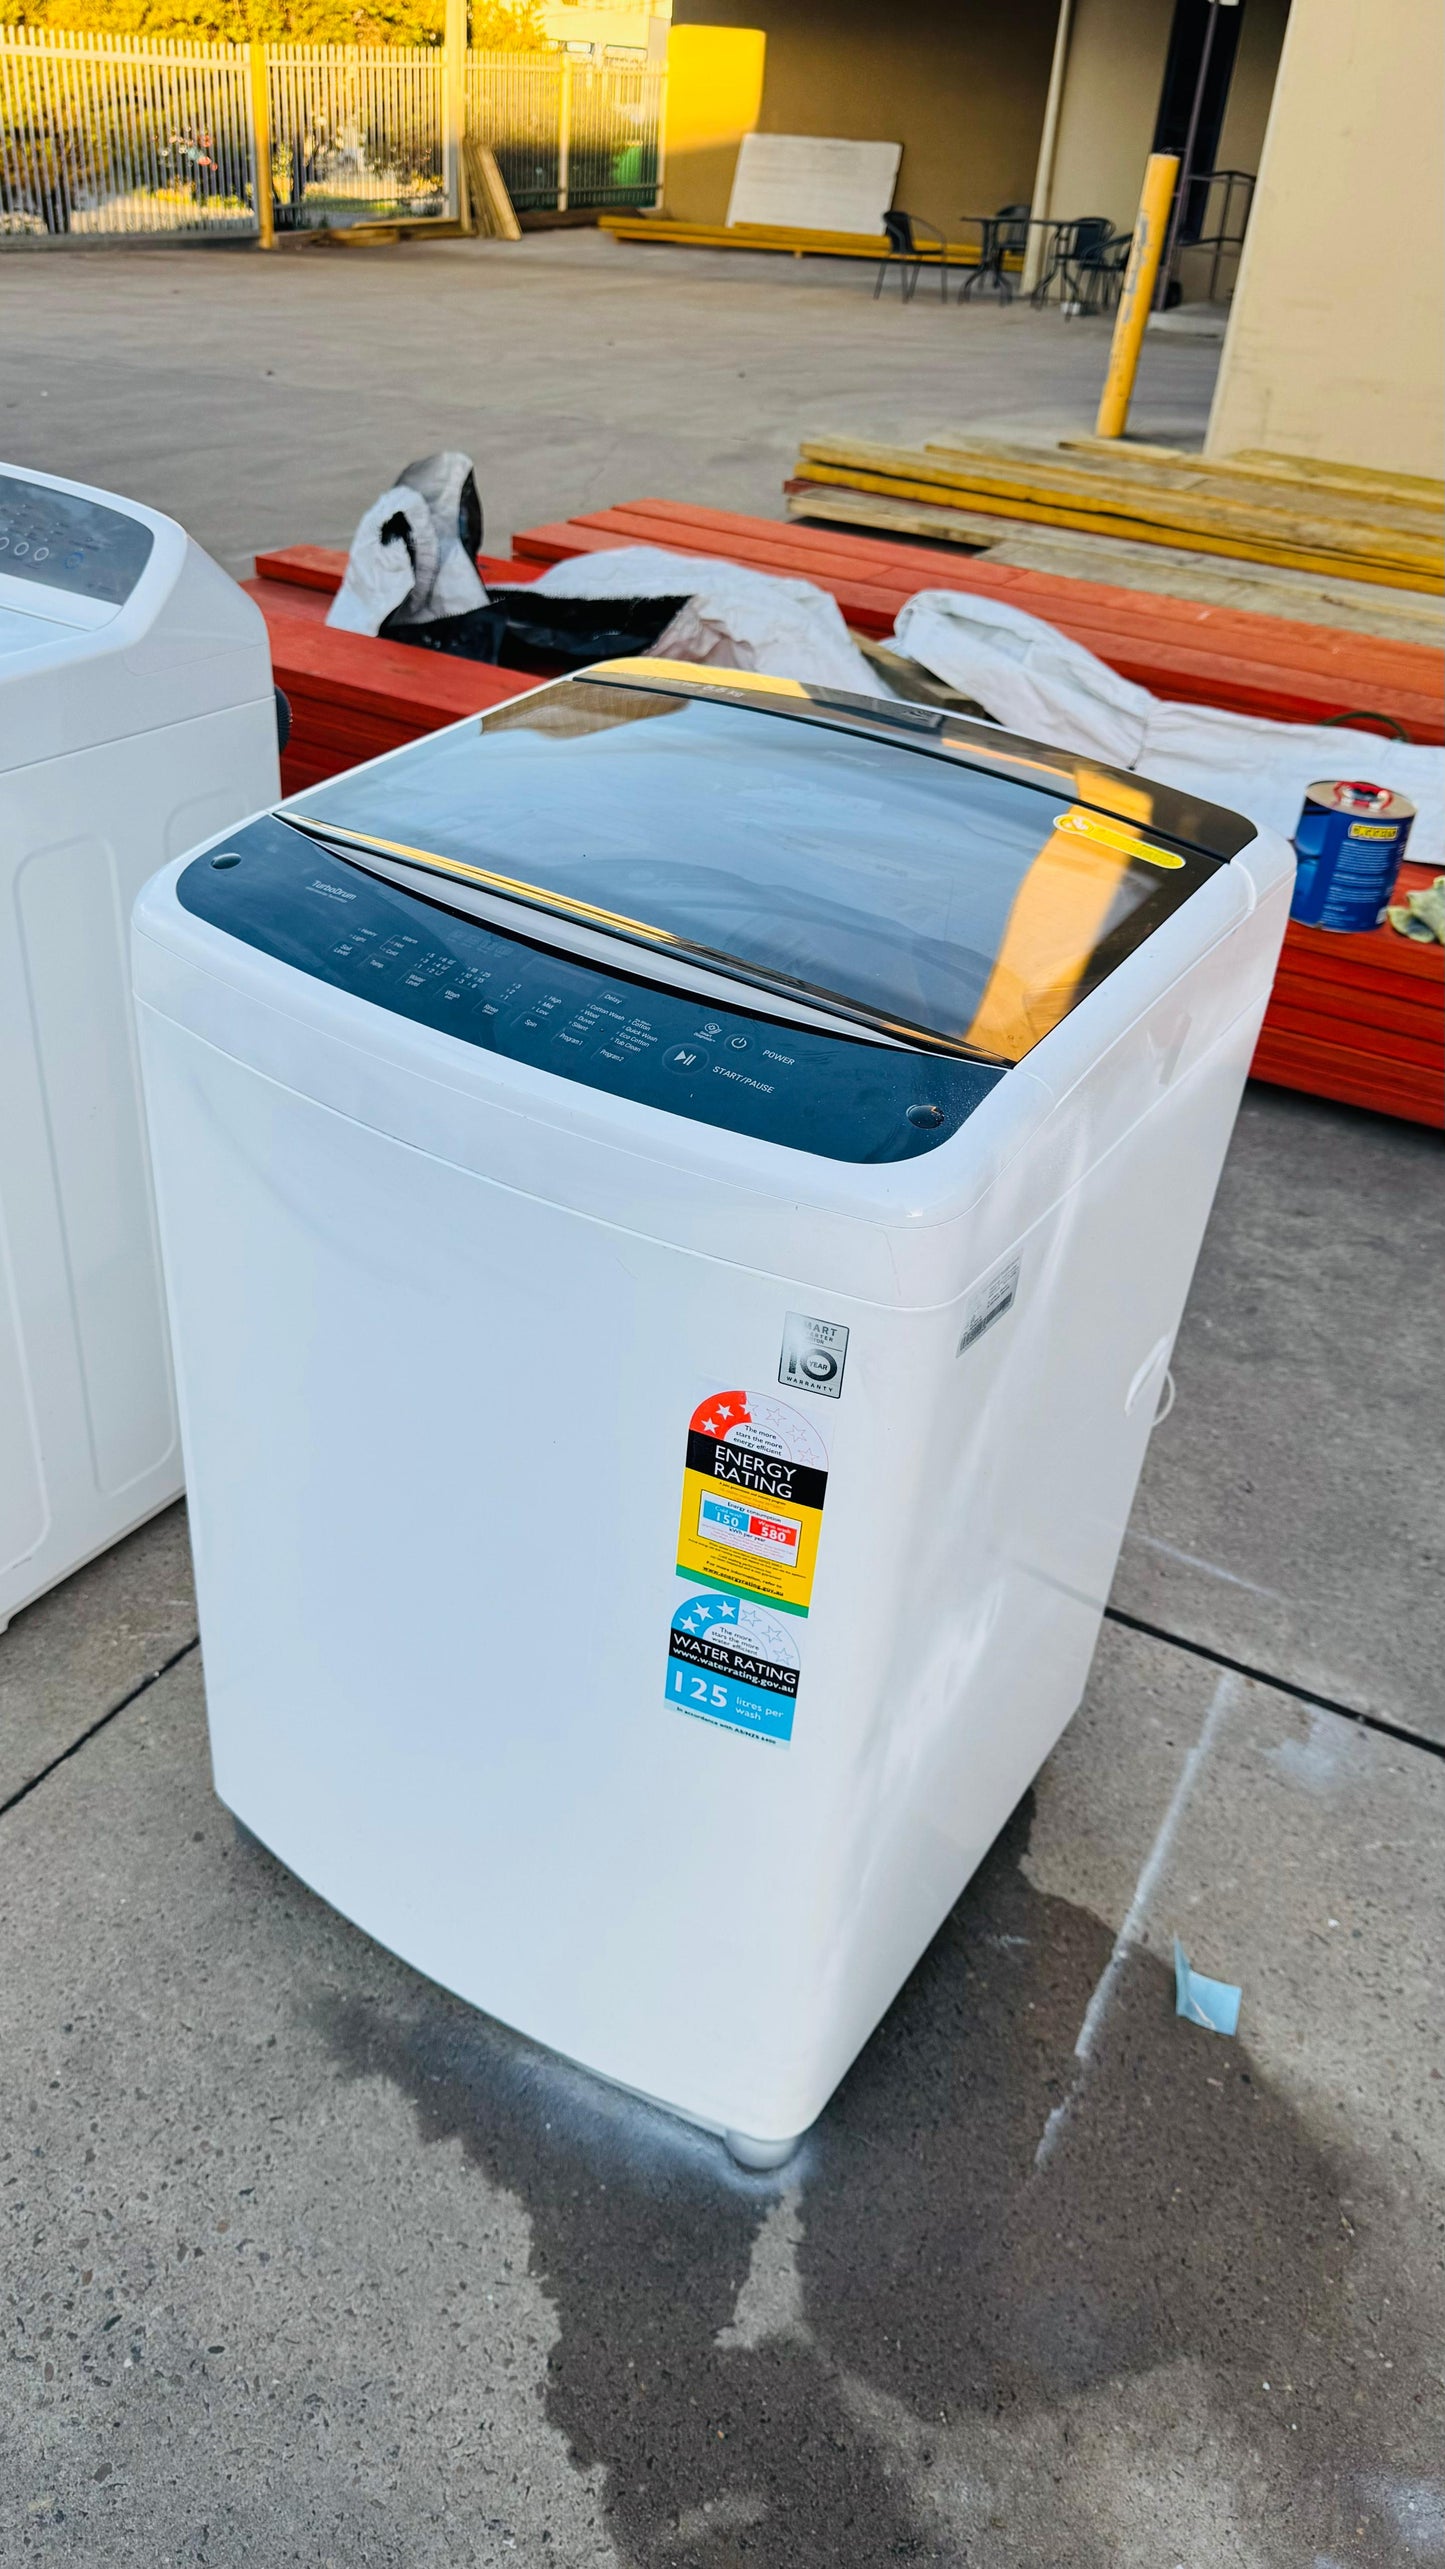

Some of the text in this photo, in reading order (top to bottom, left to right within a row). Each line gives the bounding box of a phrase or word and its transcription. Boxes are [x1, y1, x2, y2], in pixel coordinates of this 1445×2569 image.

[312, 880, 357, 900] TurboDrum
[402, 935, 418, 944] Warm
[333, 947, 350, 957] Level
[385, 948, 399, 956] Cold
[543, 1000, 555, 1009] Mid
[549, 995, 562, 1004] High
[604, 993, 622, 1005] Delay
[536, 1007, 549, 1016] Low
[584, 1009, 600, 1019] Wool
[590, 1003, 610, 1015] Cotton
[609, 1011, 625, 1022] Wash
[525, 1019, 538, 1029] Spin
[571, 1021, 589, 1032] Silent
[577, 1014, 596, 1026] Duvet
[631, 1020, 651, 1031] Cotton
[619, 1032, 650, 1048] Eco Cotton
[625, 1025, 658, 1043] Quick Wash
[614, 1038, 641, 1053] Tub Clean
[763, 1049, 795, 1066] POWER
[712, 1065, 775, 1094] START/PAUSE
[788, 1347, 838, 1382] 10
[810, 1361, 828, 1371] YEAR
[786, 1376, 834, 1392] WARRANTY
[745, 1425, 777, 1440] The more
[733, 1437, 782, 1456] energy efficient
[735, 1431, 783, 1450] stars the more
[715, 1444, 797, 1482] ENERGY
[714, 1461, 792, 1499] RATING
[715, 1505, 728, 1514] Cold
[727, 1501, 782, 1523] Energy consumption
[716, 1512, 739, 1527] 150
[758, 1520, 776, 1530] Warm
[729, 1528, 743, 1536] kWh
[761, 1526, 786, 1542] 580
[712, 1631, 760, 1650] stars the more
[720, 1627, 752, 1642] The more
[712, 1637, 758, 1656] water efficient
[673, 1633, 797, 1684] WATER RATING
[673, 1647, 794, 1694] www.waterrating.gov.au
[674, 1671, 728, 1708] 125
[735, 1708, 761, 1721] wash
[736, 1696, 784, 1718] litres per
[684, 1710, 718, 1725] accordance
[734, 1728, 759, 1739] AS/NZS
